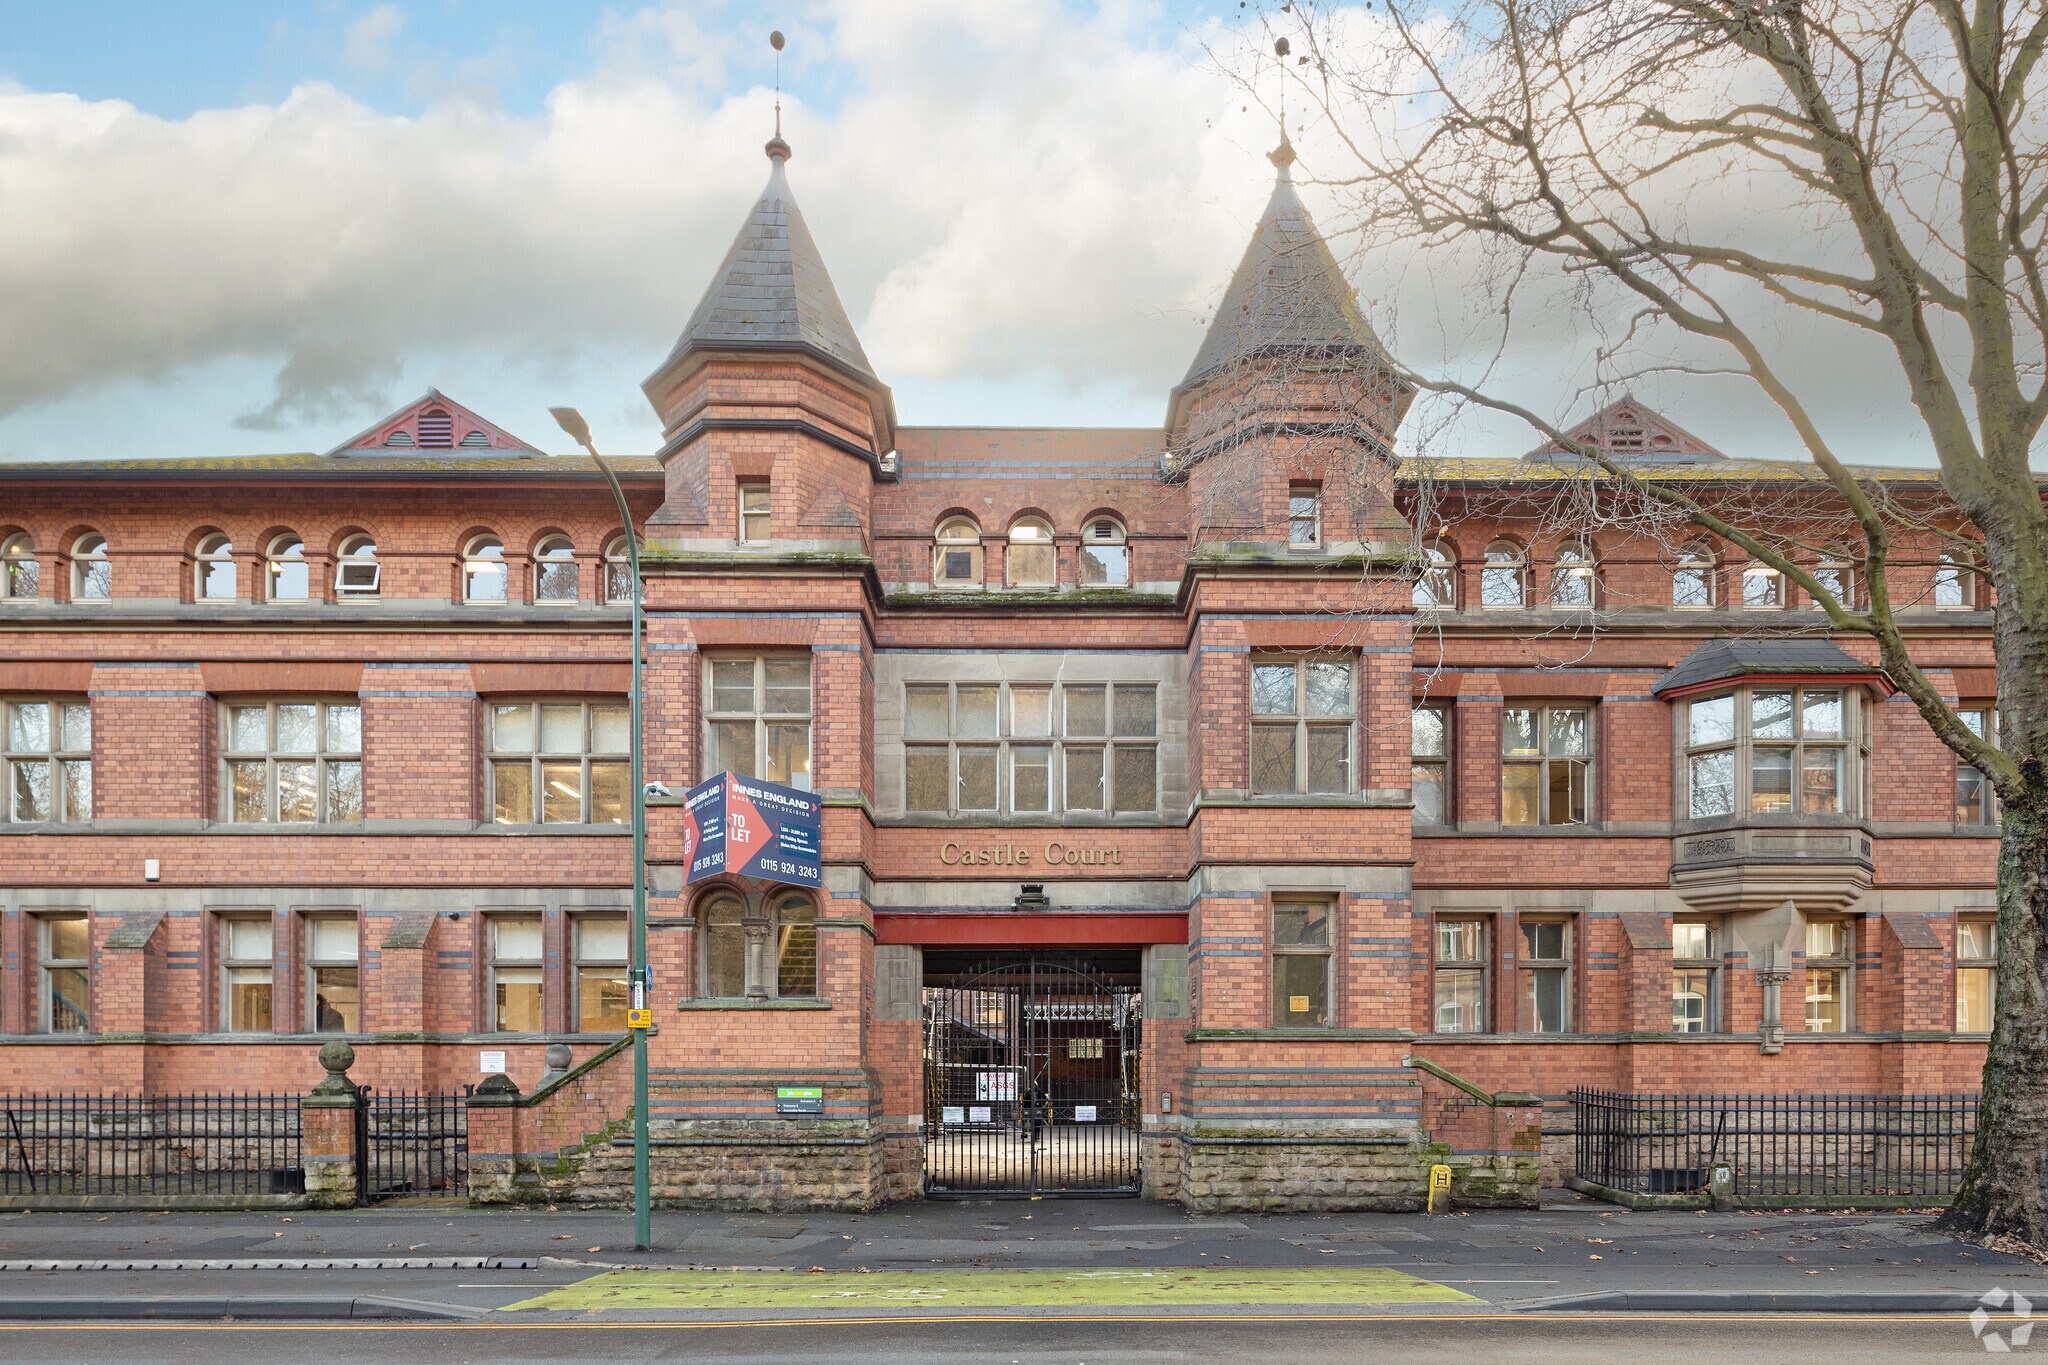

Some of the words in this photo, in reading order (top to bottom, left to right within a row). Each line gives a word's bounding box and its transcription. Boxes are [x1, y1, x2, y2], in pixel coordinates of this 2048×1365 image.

[697, 785, 720, 804] ENGLAND
[732, 784, 762, 798] INNES
[764, 791, 809, 810] ENGLAND
[759, 801, 778, 810] GREAT
[782, 806, 810, 818] DECISION
[731, 814, 745, 828] TO
[685, 828, 690, 841] TO
[731, 828, 750, 844] LET
[694, 858, 702, 872] 0115
[702, 856, 711, 869] 924
[711, 852, 724, 866] 3243
[940, 842, 1030, 865] Castle
[1044, 842, 1121, 865] Court
[761, 858, 778, 872] 0115
[781, 862, 795, 875] 924
[798, 865, 818, 879] 3243
[1437, 1172, 1447, 1185] H
